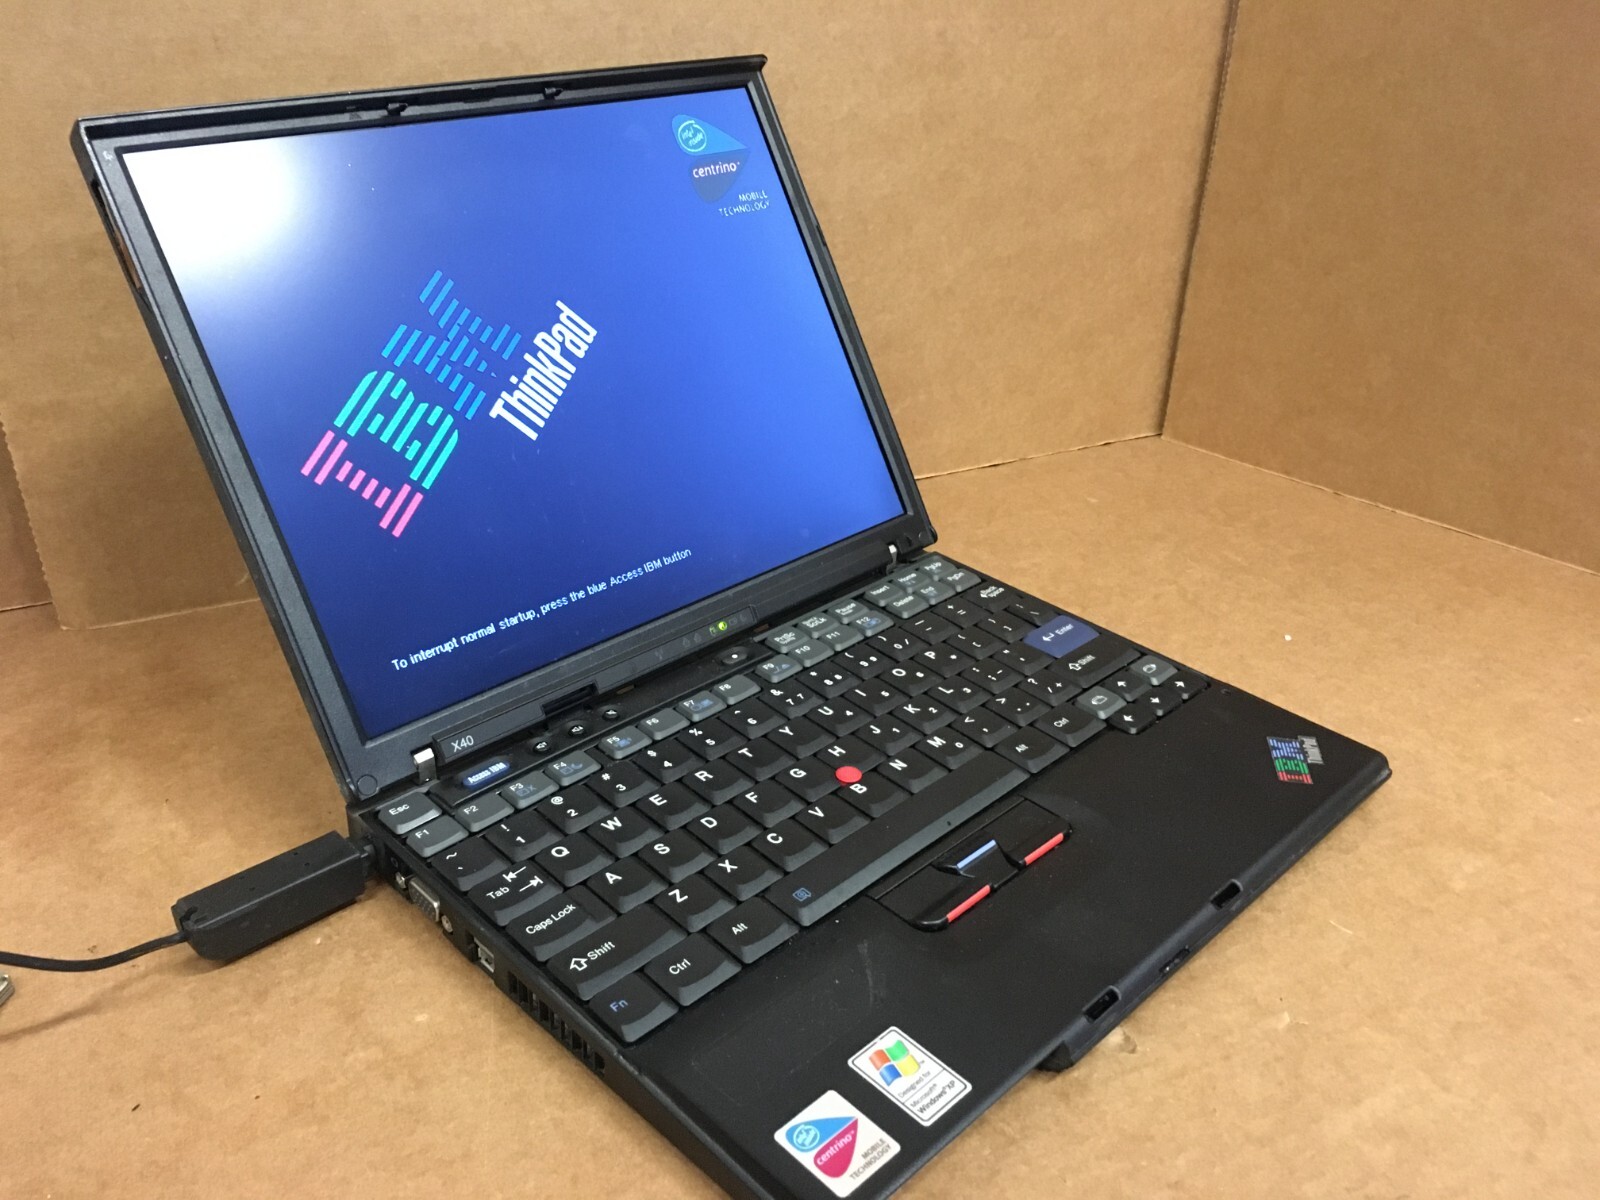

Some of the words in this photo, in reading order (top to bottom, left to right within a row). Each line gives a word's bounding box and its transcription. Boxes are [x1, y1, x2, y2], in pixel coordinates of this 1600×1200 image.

[692, 161, 738, 178] centrino
[738, 190, 768, 202] MOBILE
[488, 299, 598, 441] ThinkPad
[300, 269, 522, 538] IBM
[391, 659, 408, 671] To
[409, 637, 459, 665] interrupt
[460, 623, 496, 645] normal
[498, 608, 541, 630] startup,
[540, 596, 569, 616] press
[569, 590, 586, 602] the
[586, 581, 608, 595] blue
[609, 567, 644, 586] Access
[643, 559, 662, 573] IBM
[662, 549, 692, 566] button
[855, 616, 871, 625] F12
[825, 631, 841, 640] F11
[794, 645, 811, 655] F10
[923, 651, 936, 660] P
[762, 662, 775, 670] F9
[891, 669, 907, 677] O
[718, 683, 732, 692] F8
[683, 699, 695, 708] F7
[903, 704, 921, 714] K
[817, 706, 834, 716] U
[646, 716, 660, 726] F6
[778, 726, 794, 736] Y
[869, 725, 881, 734] J
[451, 734, 475, 753] X40
[606, 735, 621, 745] F5
[926, 736, 947, 748] M
[737, 748, 753, 758] T
[827, 746, 846, 757] H
[888, 759, 908, 771] N
[694, 771, 714, 782] R
[789, 769, 807, 778] G
[510, 783, 523, 791] F3
[849, 781, 868, 793] B
[648, 794, 668, 806] E
[745, 792, 758, 803] F
[389, 805, 409, 815] Esc
[464, 806, 478, 814] F2
[807, 807, 825, 818] V
[600, 817, 623, 831] W
[699, 817, 718, 829] D
[414, 827, 430, 839] F1
[766, 833, 783, 844] C
[550, 847, 571, 858] Q
[653, 844, 671, 855] S
[717, 860, 738, 873] X
[605, 873, 623, 885] A
[487, 887, 509, 898] Tab
[668, 889, 689, 903] Z
[526, 918, 553, 935] Caps
[550, 904, 577, 923] Lock
[732, 923, 747, 934] Alt
[586, 941, 616, 962] Shift
[669, 959, 690, 974] Ctrl
[610, 1000, 628, 1011] Fn
[816, 1133, 853, 1166] centrino
